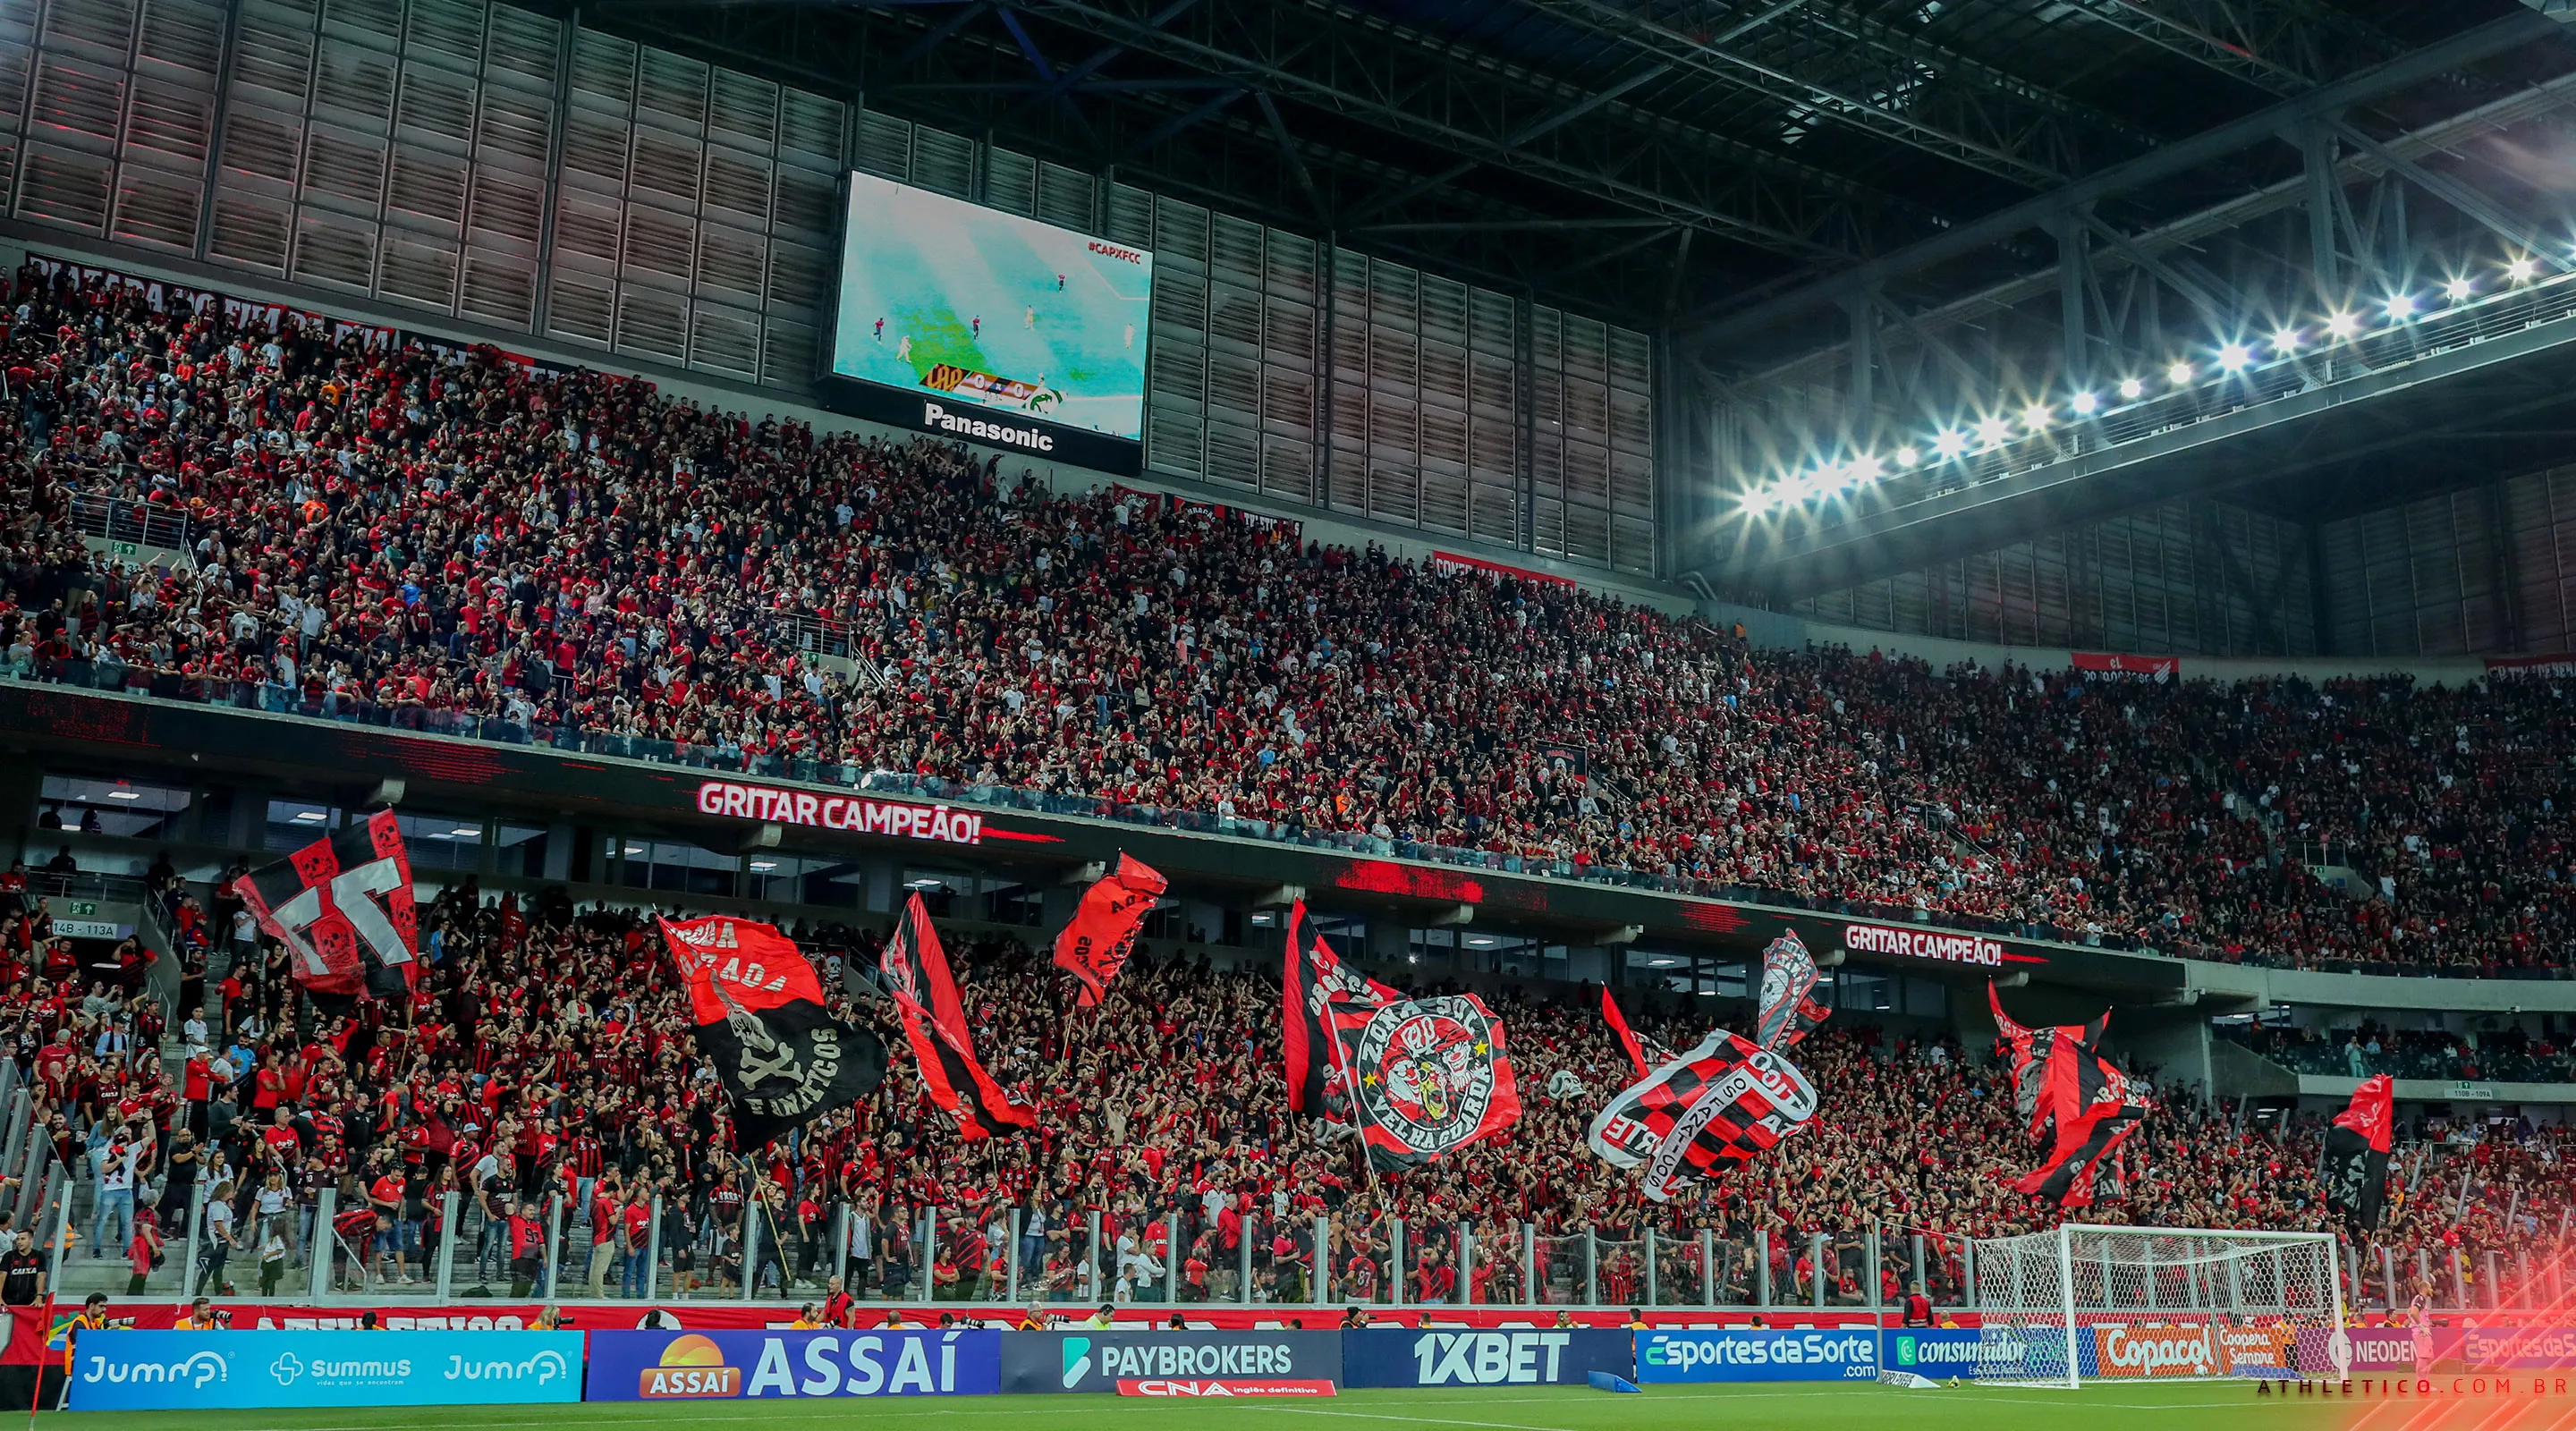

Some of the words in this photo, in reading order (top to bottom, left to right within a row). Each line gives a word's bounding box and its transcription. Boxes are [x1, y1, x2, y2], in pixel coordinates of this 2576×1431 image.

[1087, 241, 1141, 265] #CAPXFCC
[924, 402, 1054, 452] Panasonic
[699, 783, 817, 826] GRITAR
[823, 799, 981, 844] CAMPEÃO!
[88, 925, 114, 936] 113A
[1846, 925, 1911, 956] GRITAR
[1913, 934, 2003, 966] CAMPEÃO!
[1361, 1001, 1422, 1064] ZONA
[1372, 1094, 1436, 1149] VELHA
[1438, 1063, 1492, 1146] GUARDA
[1648, 1097, 1726, 1189] FANATICOS
[12, 1267, 38, 1276] CAIXA
[1356, 1269, 1372, 1288] 87
[2107, 1327, 2214, 1376] Copacol
[2220, 1329, 2271, 1351] Coopera
[2356, 1340, 2418, 1363] NEODEN
[1102, 1343, 1292, 1377] PAYBROKERS
[1413, 1332, 1571, 1384] 1XBET
[2229, 1347, 2275, 1366] Sempre
[1843, 1365, 1877, 1378] .com
[1137, 1380, 1235, 1397] CNA
[1233, 1385, 1266, 1396] inglês
[1267, 1385, 1318, 1395] definitivo
